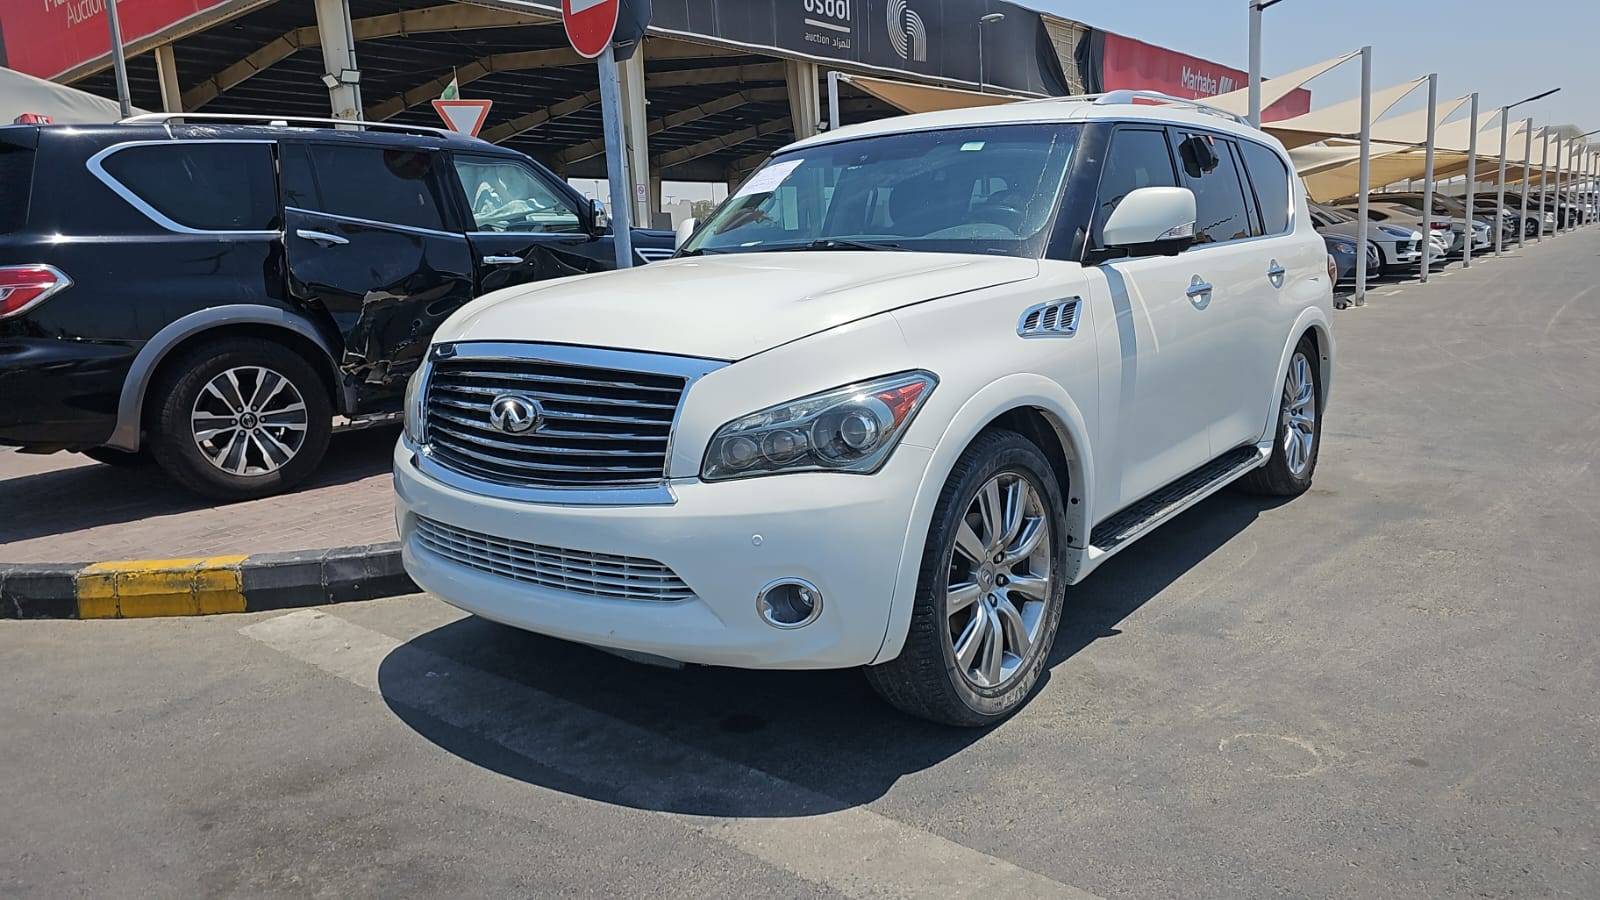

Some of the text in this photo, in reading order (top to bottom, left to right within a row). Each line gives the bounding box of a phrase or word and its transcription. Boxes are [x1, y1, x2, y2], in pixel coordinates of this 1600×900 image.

[66, 0, 107, 28] Auction
[805, 32, 829, 45] auction
[1181, 65, 1217, 94] Marhaba
